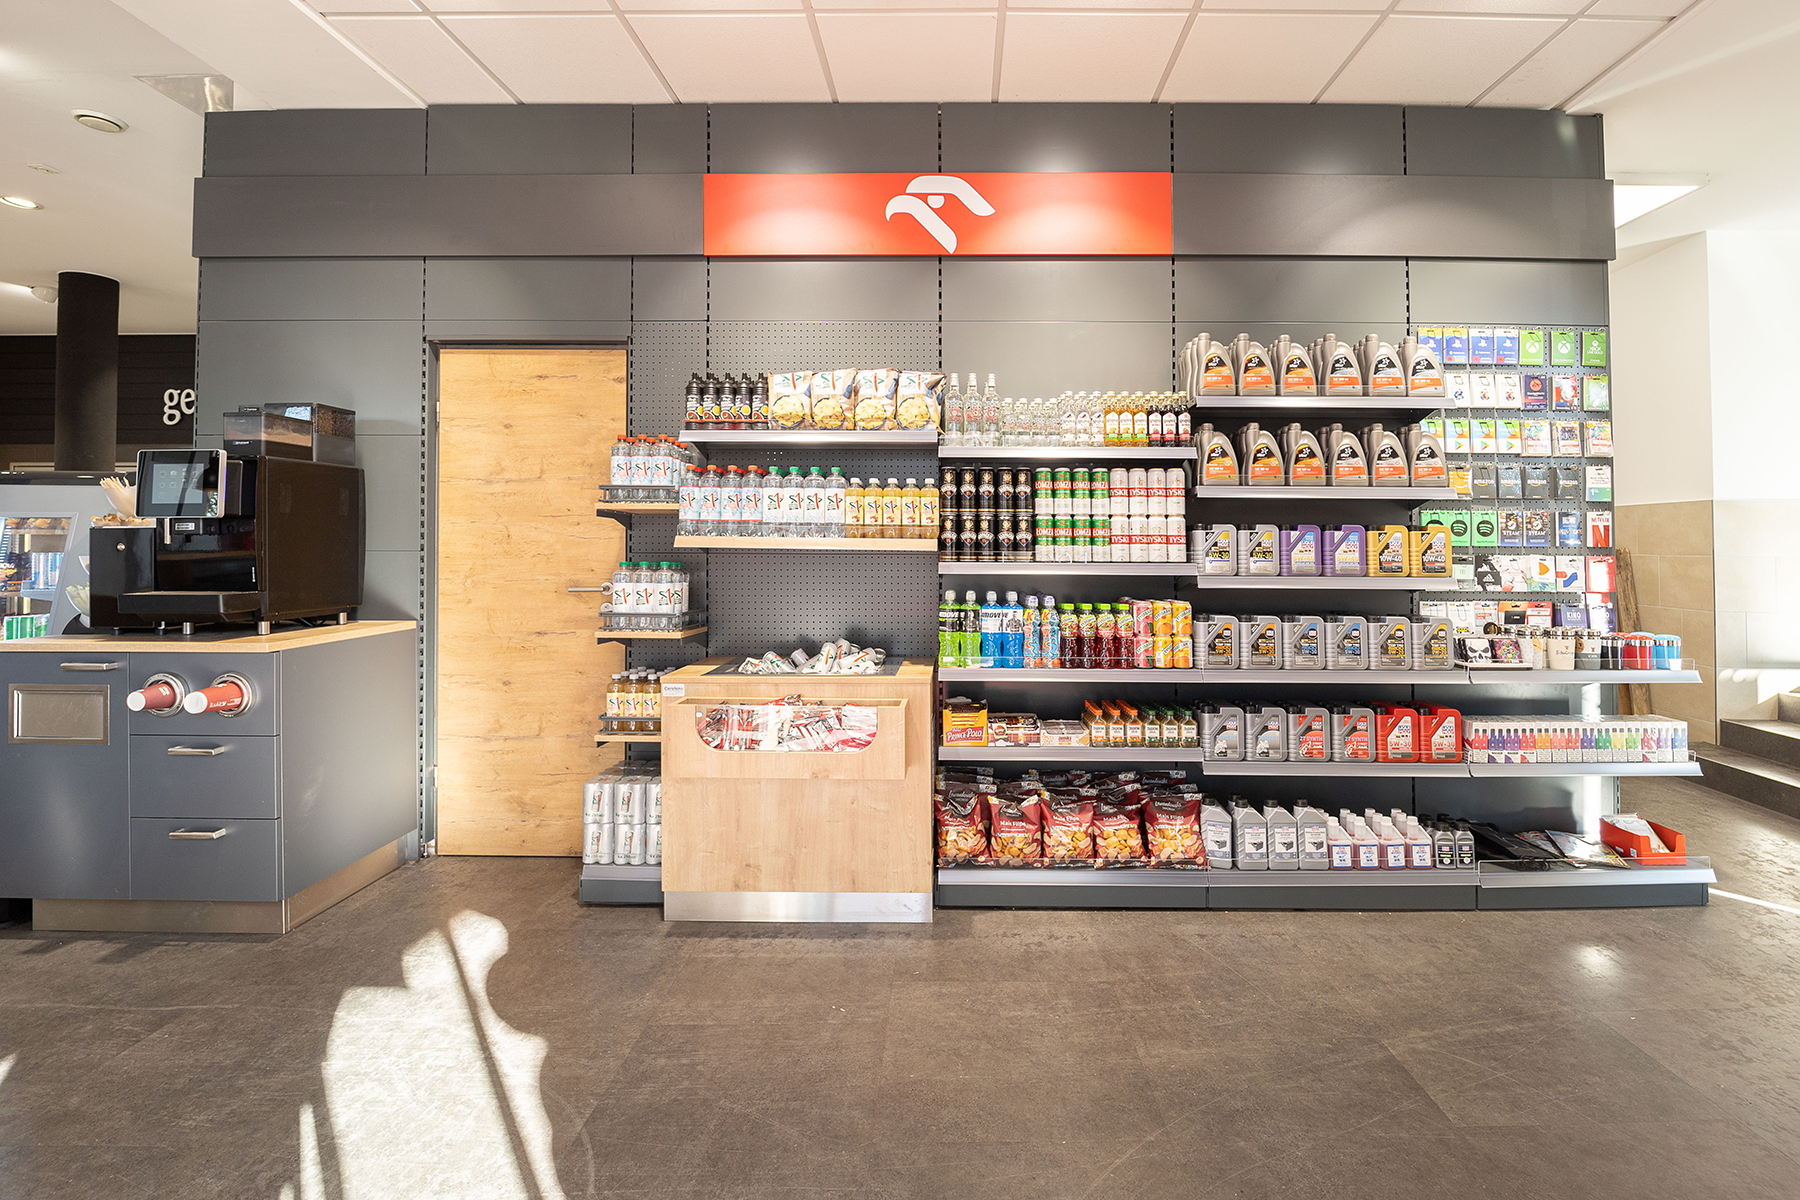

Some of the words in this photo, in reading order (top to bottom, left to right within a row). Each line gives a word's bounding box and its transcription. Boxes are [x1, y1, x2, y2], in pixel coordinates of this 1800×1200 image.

[163, 389, 195, 425] ge
[946, 732, 966, 742] PRINCE
[966, 728, 982, 738] POLO
